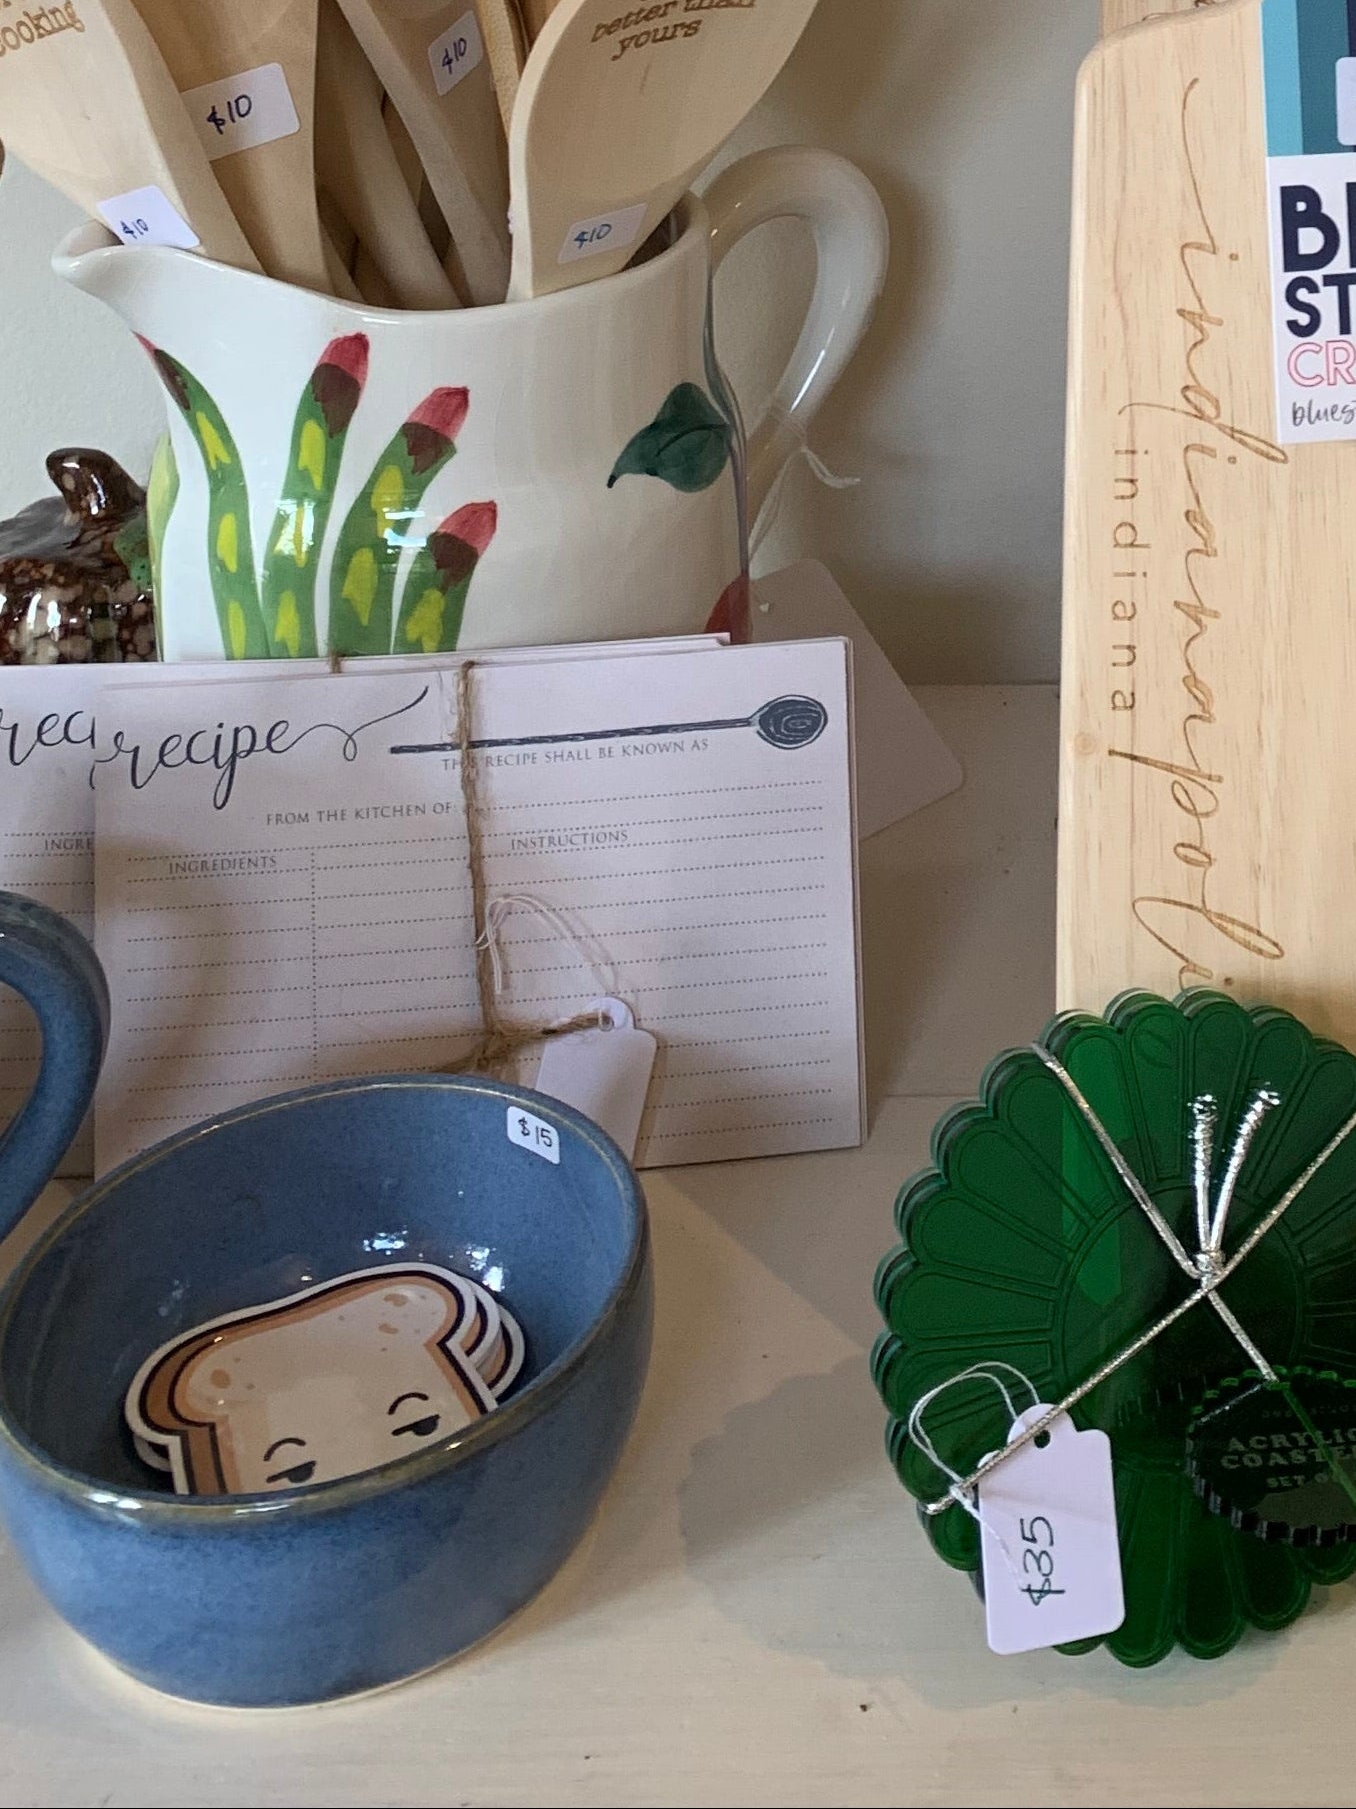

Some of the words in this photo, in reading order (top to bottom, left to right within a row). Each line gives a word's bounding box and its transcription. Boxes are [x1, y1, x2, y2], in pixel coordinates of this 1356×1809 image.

[591, 0, 678, 43] better
[611, 19, 702, 61] yours
[440, 37, 468, 75] $10
[206, 93, 253, 135] $10
[120, 218, 149, 240] $10
[573, 223, 613, 249] $10
[1107, 77, 1289, 991] indianapoli
[1110, 448, 1151, 712] indiana
[96, 686, 429, 810] recipe
[442, 756, 477, 772] THS
[484, 752, 539, 769] RECIPE
[543, 749, 592, 765] SHALL
[597, 745, 615, 760] BE
[621, 740, 685, 758] KNOWN
[690, 738, 710, 752] AS
[266, 812, 310, 827] FROM
[316, 808, 348, 824] THE
[354, 802, 427, 821] KITCHEN
[510, 829, 629, 852] INSTRUCTIONS
[168, 854, 278, 877] INGREDIENTS
[1266, 1474, 1306, 1488] SET
[1018, 1515, 1067, 1607] $35
